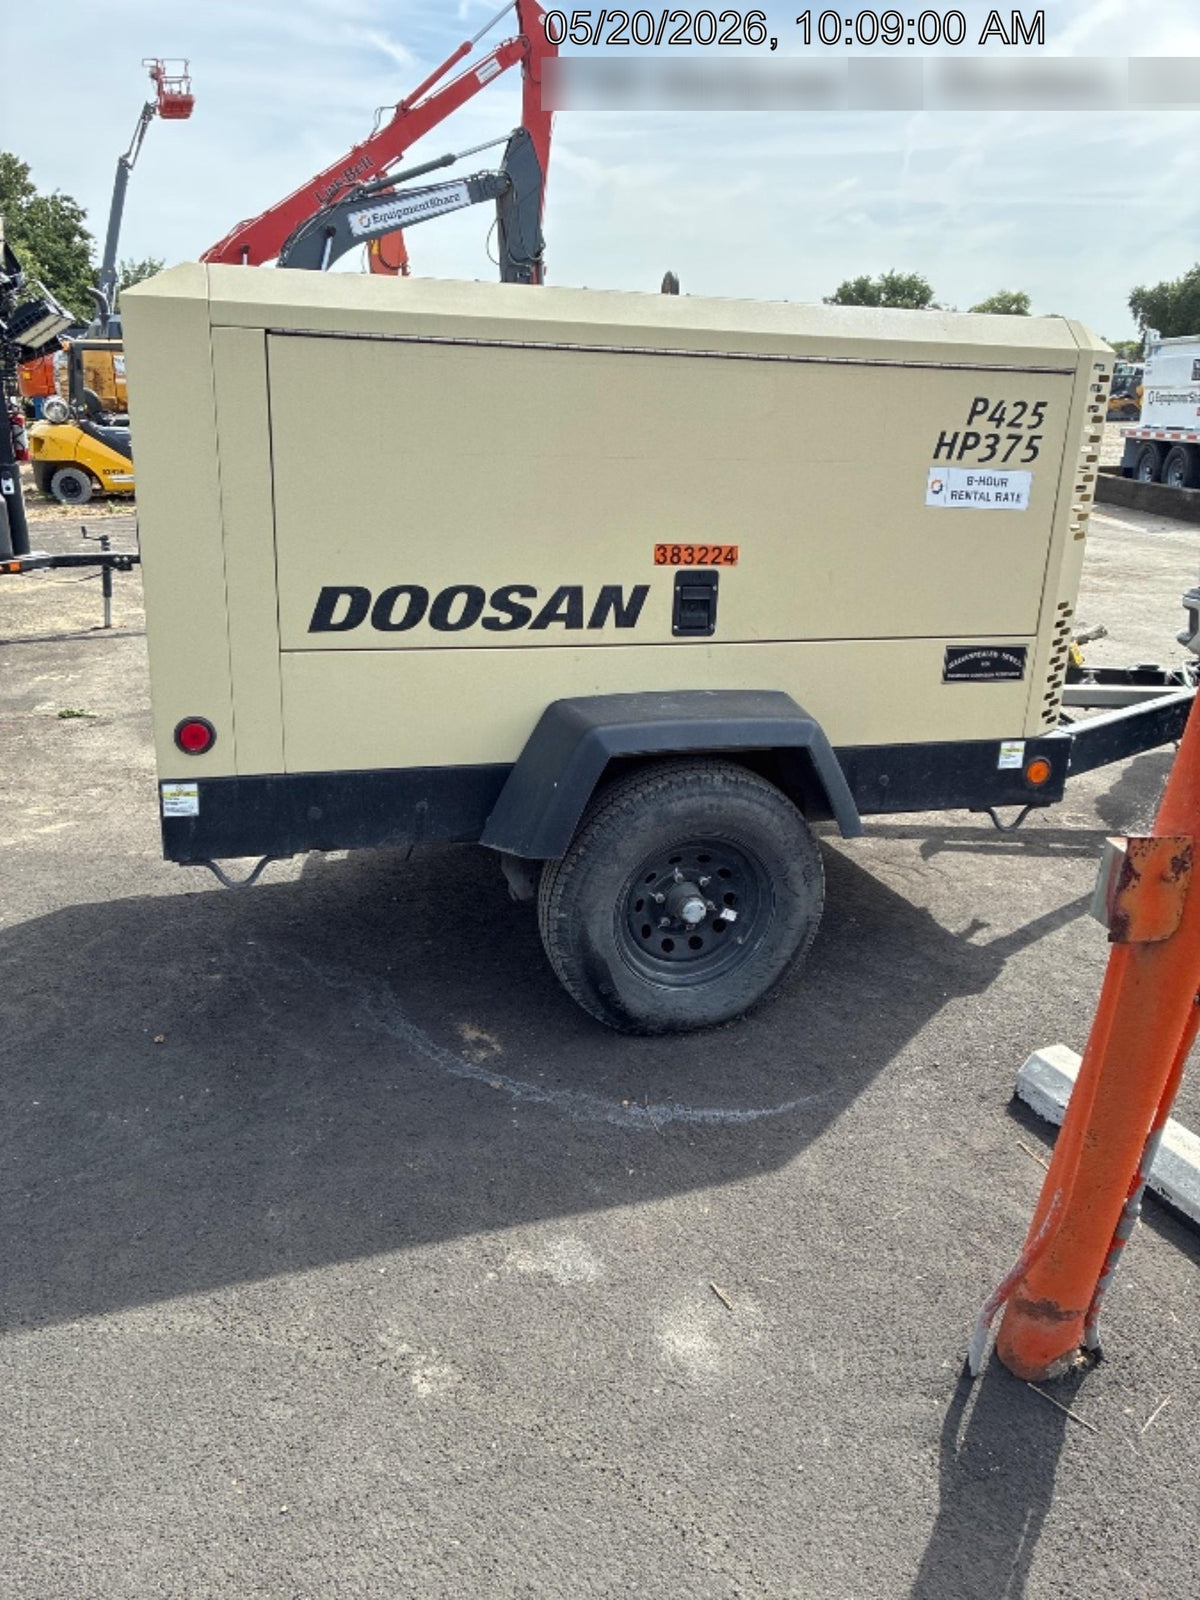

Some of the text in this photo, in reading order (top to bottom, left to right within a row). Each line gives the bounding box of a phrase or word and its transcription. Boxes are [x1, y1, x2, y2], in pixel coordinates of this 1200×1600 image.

[966, 396, 1049, 430] P425
[932, 430, 1044, 463] HP375
[950, 489, 1022, 504] RENTAL RATE
[654, 544, 736, 566] 383224
[307, 584, 651, 633] DOOSAN
